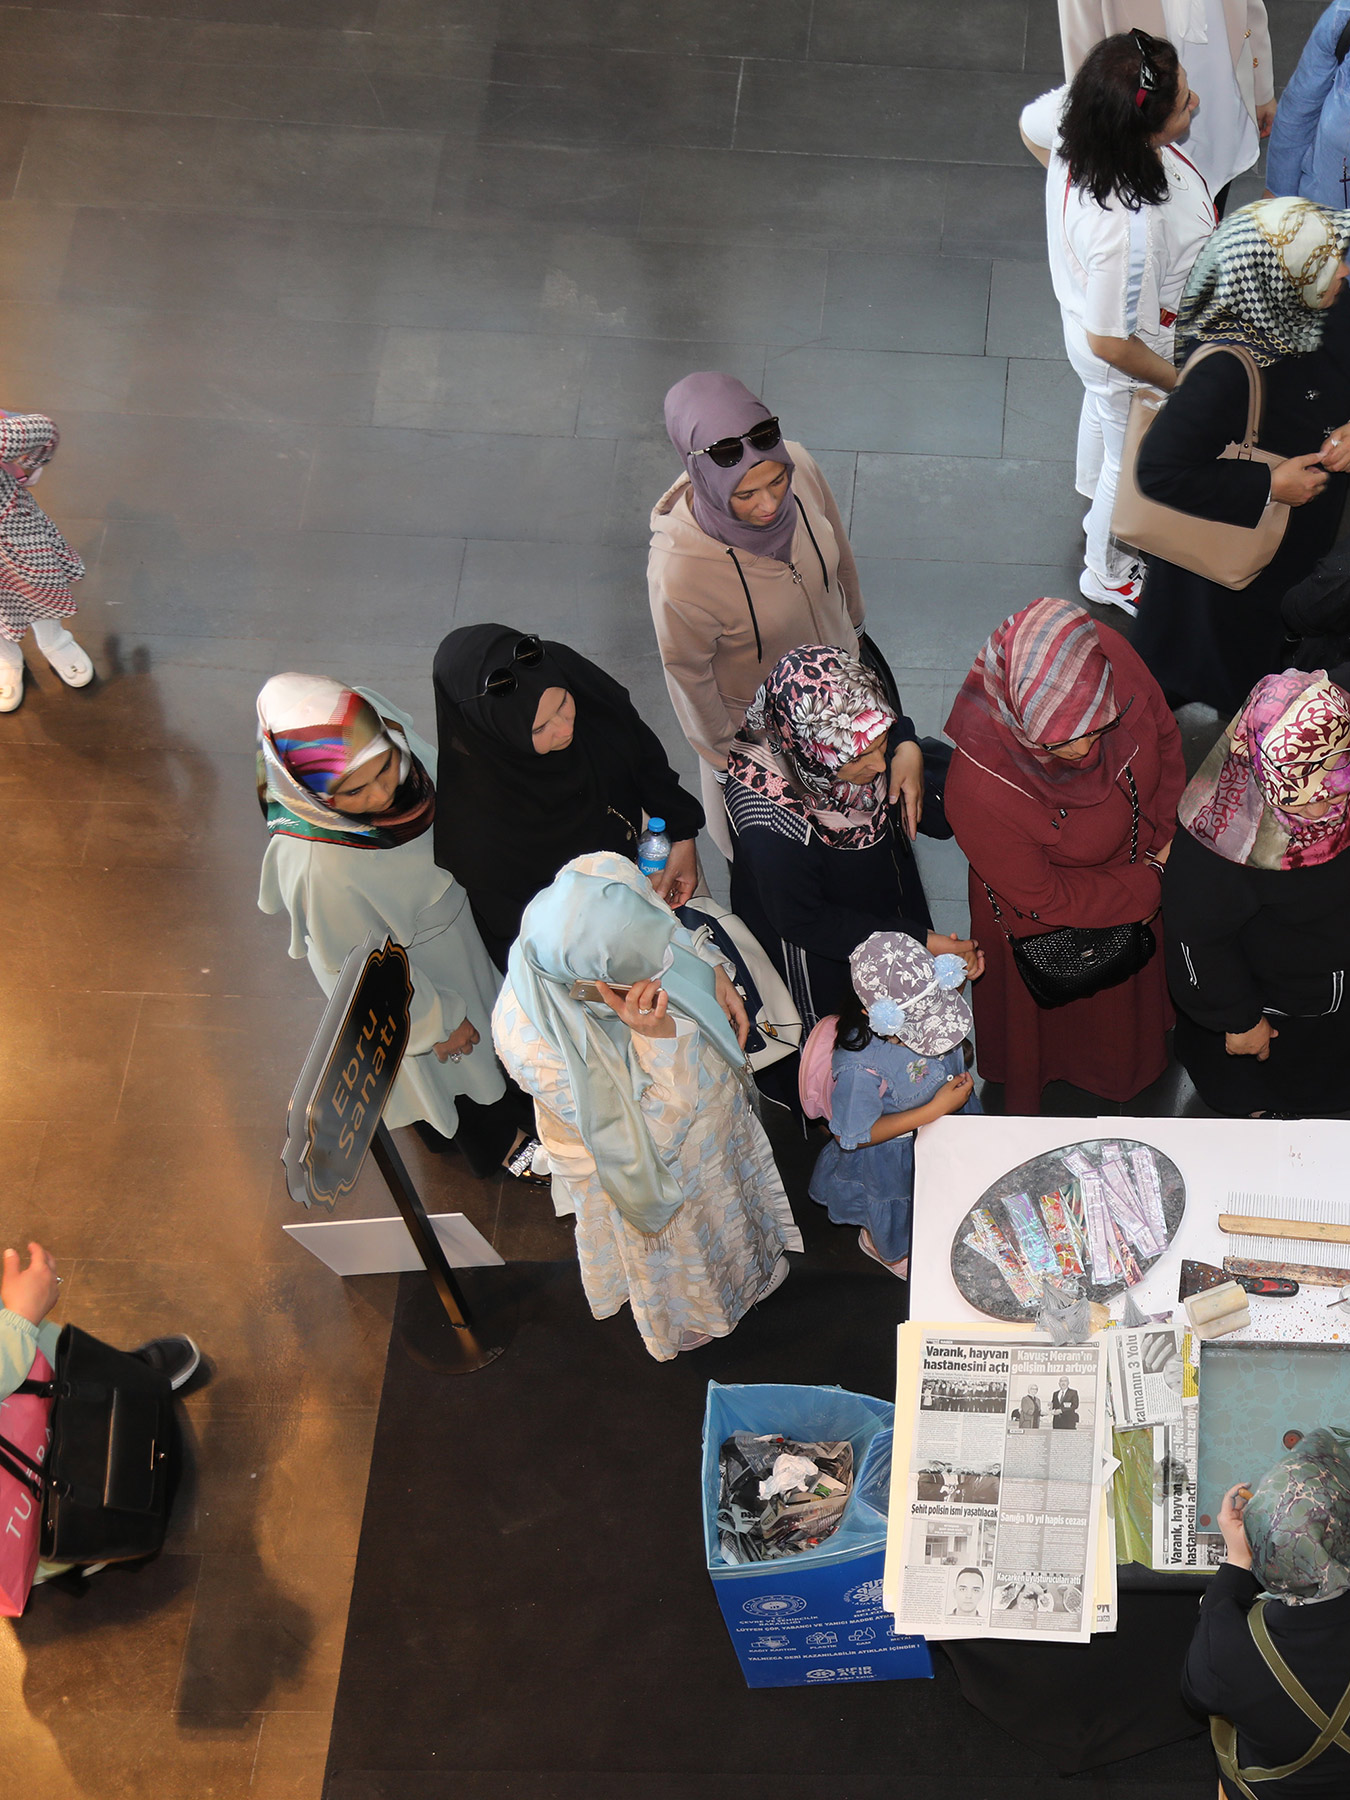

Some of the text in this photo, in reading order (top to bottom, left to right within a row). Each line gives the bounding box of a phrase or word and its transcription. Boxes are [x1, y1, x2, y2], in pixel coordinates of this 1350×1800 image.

[332, 1008, 378, 1118] Ebru
[339, 1015, 397, 1160] Sanatı
[926, 1346, 1009, 1361] Varank, hayvan
[1126, 1334, 1139, 1359] Yolu
[1017, 1350, 1049, 1363] Kavuş:
[923, 1359, 1009, 1374] hastanesini açtı
[1011, 1362, 1098, 1374] gelişim hızı artıyor
[1128, 1361, 1140, 1369] 3
[1171, 1482, 1185, 1522] hayvan
[911, 1503, 998, 1518] Şehit polisin ismi yaşatılacak
[1000, 1512, 1087, 1526] Sanığa 10 yıl hapis cezası
[1185, 1504, 1197, 1566] hastanesini
[1171, 1524, 1185, 1565] Varank,
